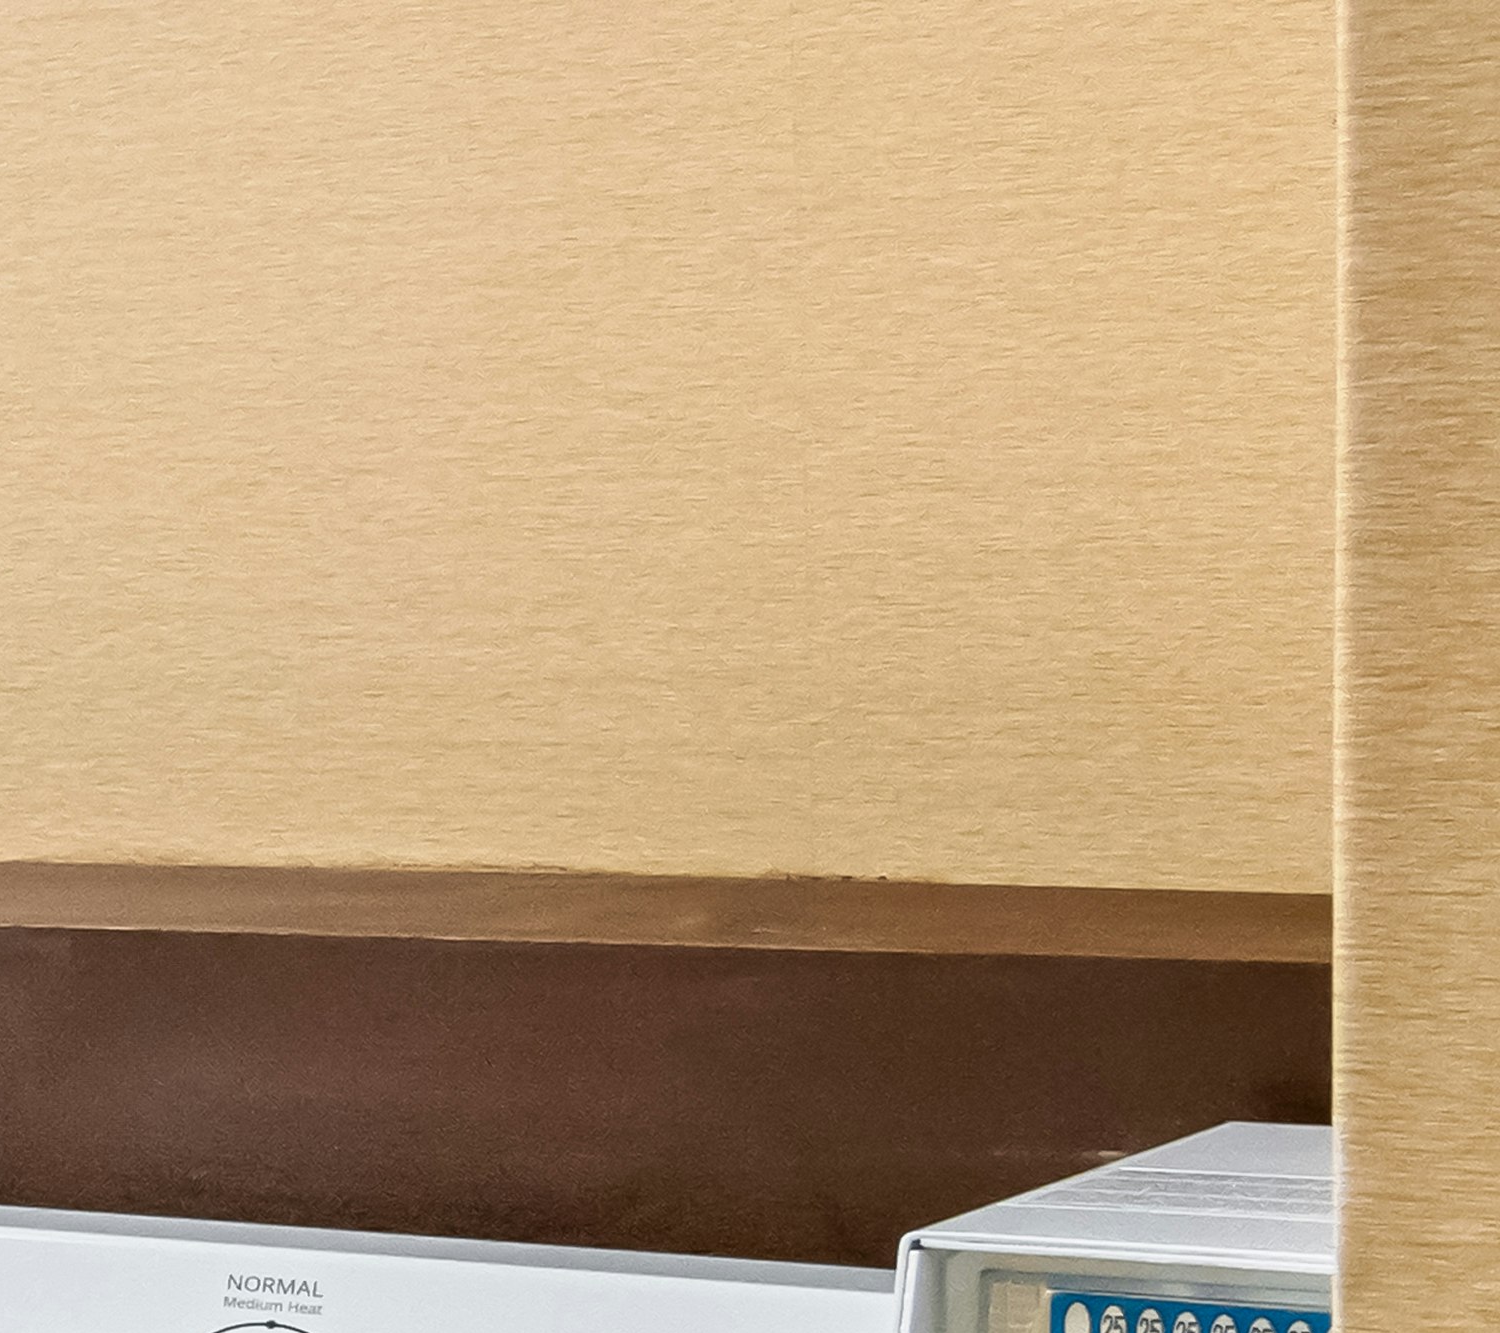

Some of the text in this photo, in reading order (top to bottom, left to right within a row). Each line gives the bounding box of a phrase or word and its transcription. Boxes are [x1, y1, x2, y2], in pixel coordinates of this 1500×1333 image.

[227, 1274, 324, 1298] NORMAL
[223, 1296, 323, 1315] Medium Heat
